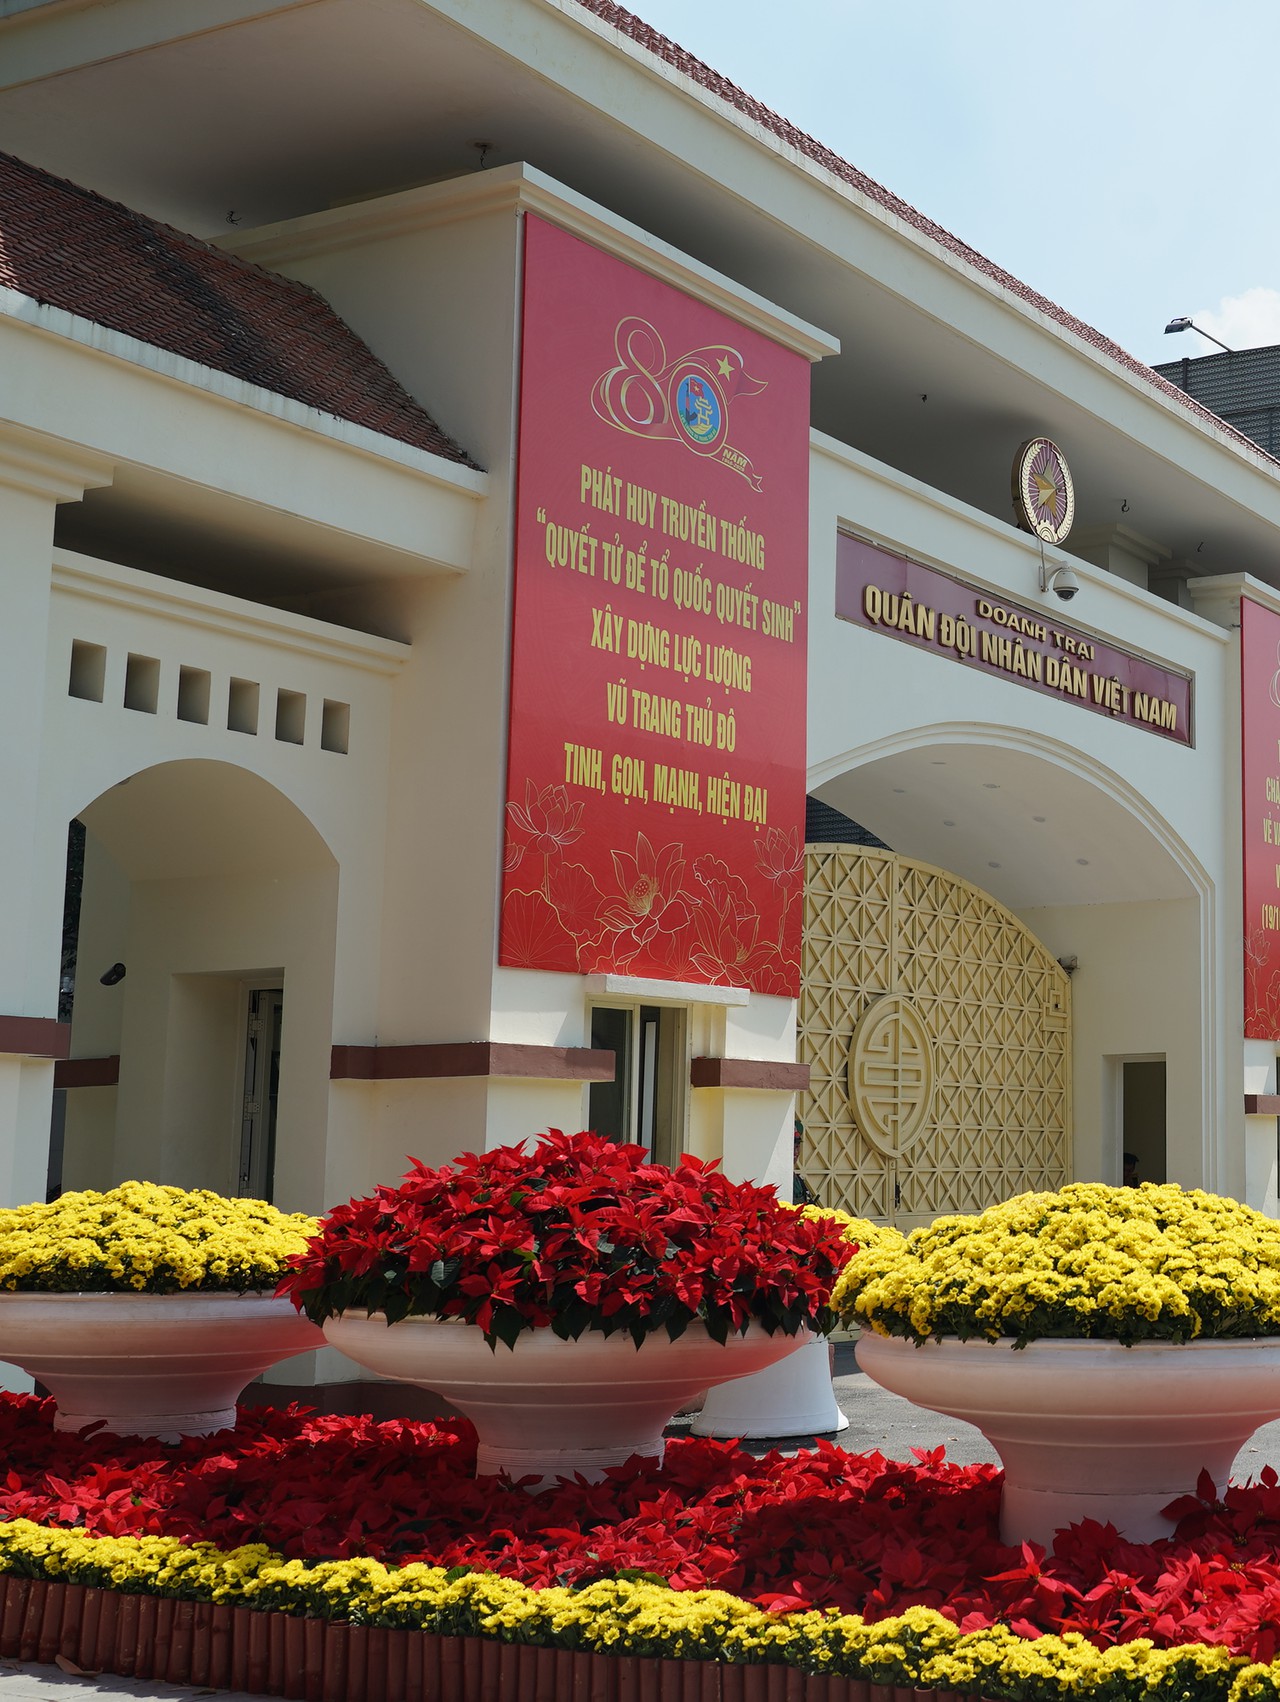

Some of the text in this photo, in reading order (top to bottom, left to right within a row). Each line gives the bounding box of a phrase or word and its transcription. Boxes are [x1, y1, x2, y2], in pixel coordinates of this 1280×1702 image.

[723, 449, 747, 467] NĂM
[581, 464, 765, 570] PHÁT HUY TRUYỀN THỐNG
[603, 533, 623, 584] TỬ
[626, 540, 648, 593] ĐỂ
[651, 549, 670, 600] TỔ
[674, 563, 712, 615] QUỐC
[716, 582, 758, 631] QUYẾT
[591, 604, 751, 694] XÂY DỰNG LỰC LƯỢNG
[864, 584, 1177, 731] QUÂN ĐỘI NHÂN DÂN VIỆT NAM
[977, 600, 1095, 661] DOANH TRẠI
[607, 678, 736, 752] VŨ TRANG THỦ ĐÔ
[564, 742, 768, 833] TINH, GỌN, MẠNH, HIỆN ĐẠI
[1264, 811, 1272, 843] VẺ
